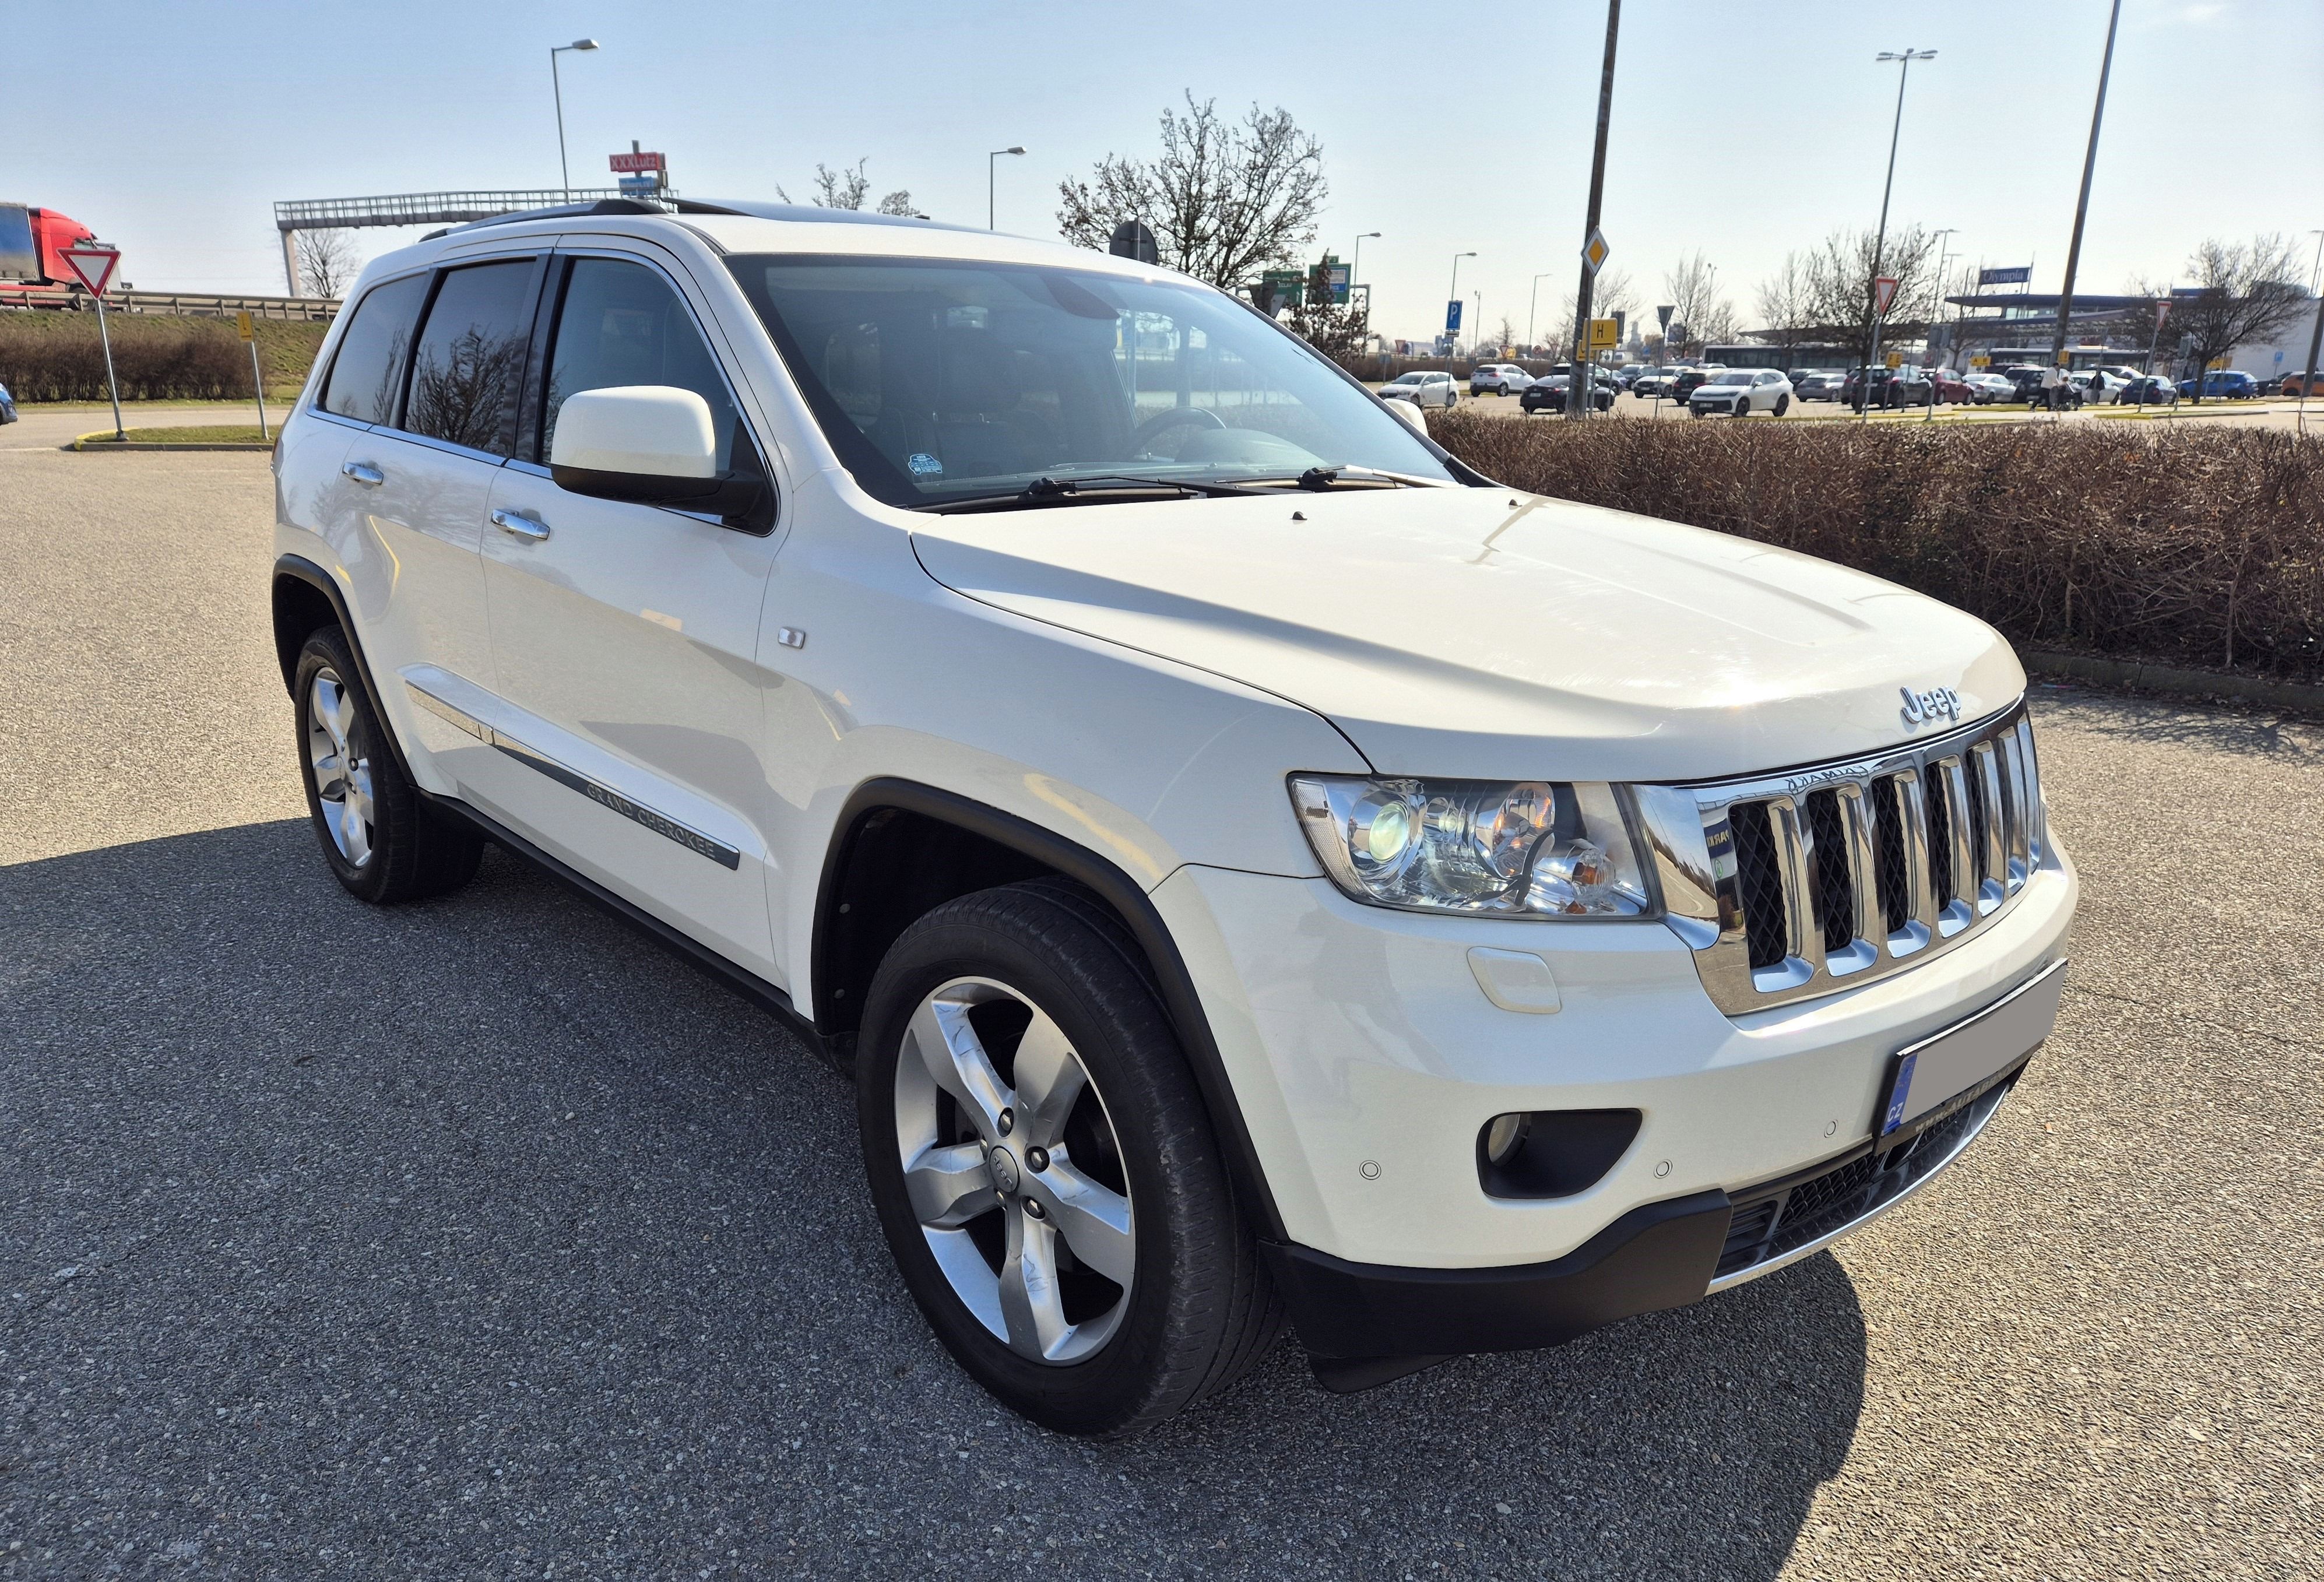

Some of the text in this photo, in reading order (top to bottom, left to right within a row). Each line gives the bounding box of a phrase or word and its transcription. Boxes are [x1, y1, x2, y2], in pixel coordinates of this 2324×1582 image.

[611, 154, 656, 170] XXXLutz
[1450, 304, 1458, 320] P
[1597, 324, 1604, 338] H
[1900, 685, 1962, 724] Jeep
[586, 783, 716, 859] GRAND CHEROKEE
[1887, 1102, 1904, 1123] CZ
[993, 1155, 1012, 1187] Jeep
